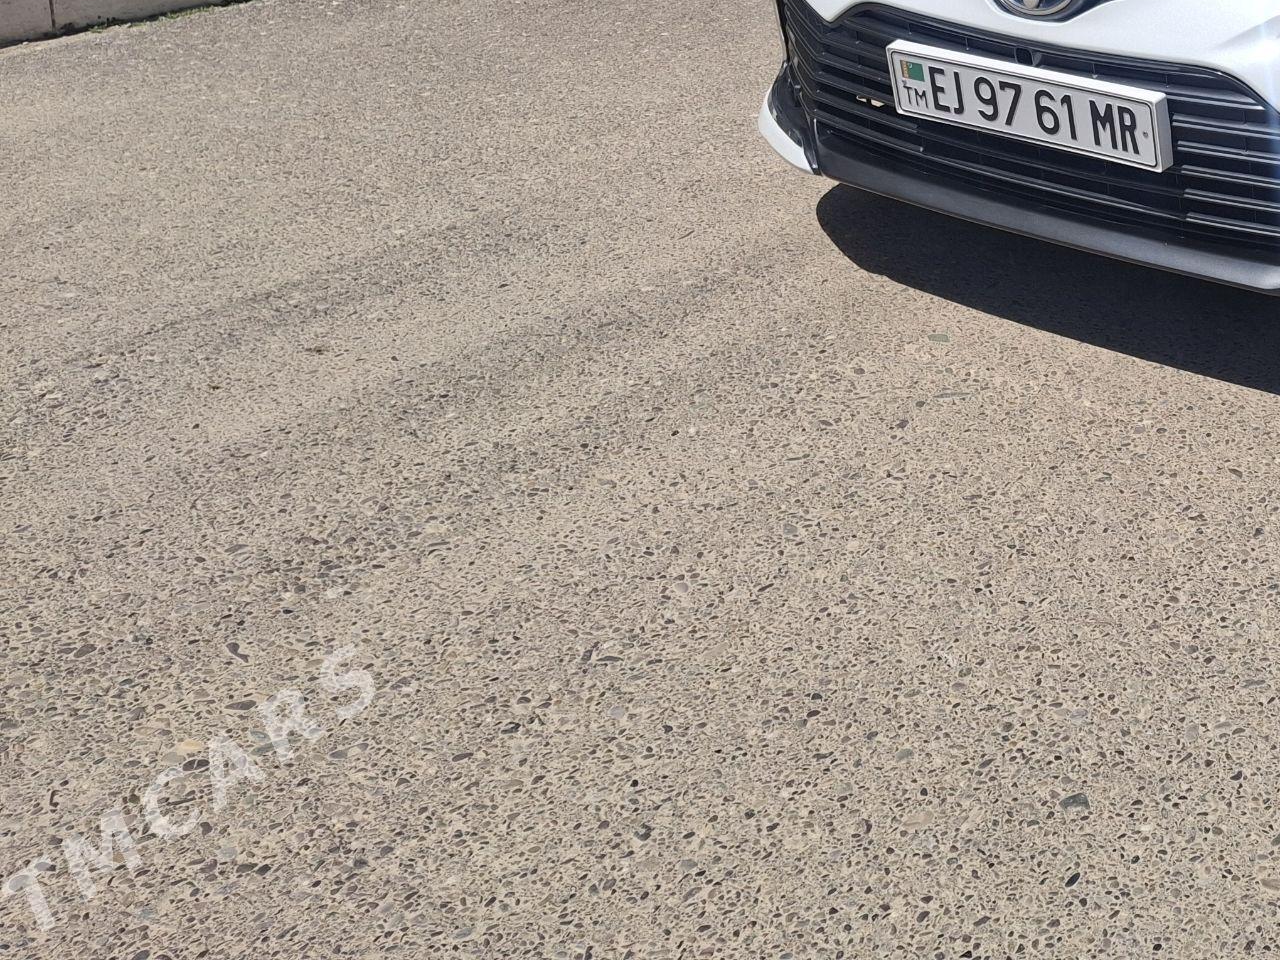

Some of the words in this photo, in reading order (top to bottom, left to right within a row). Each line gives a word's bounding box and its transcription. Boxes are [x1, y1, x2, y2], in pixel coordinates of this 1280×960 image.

[902, 85, 929, 109] TM
[928, 65, 964, 115] EJ
[973, 76, 1022, 126] 97
[1034, 89, 1078, 140] 61
[1089, 100, 1140, 155] MR
